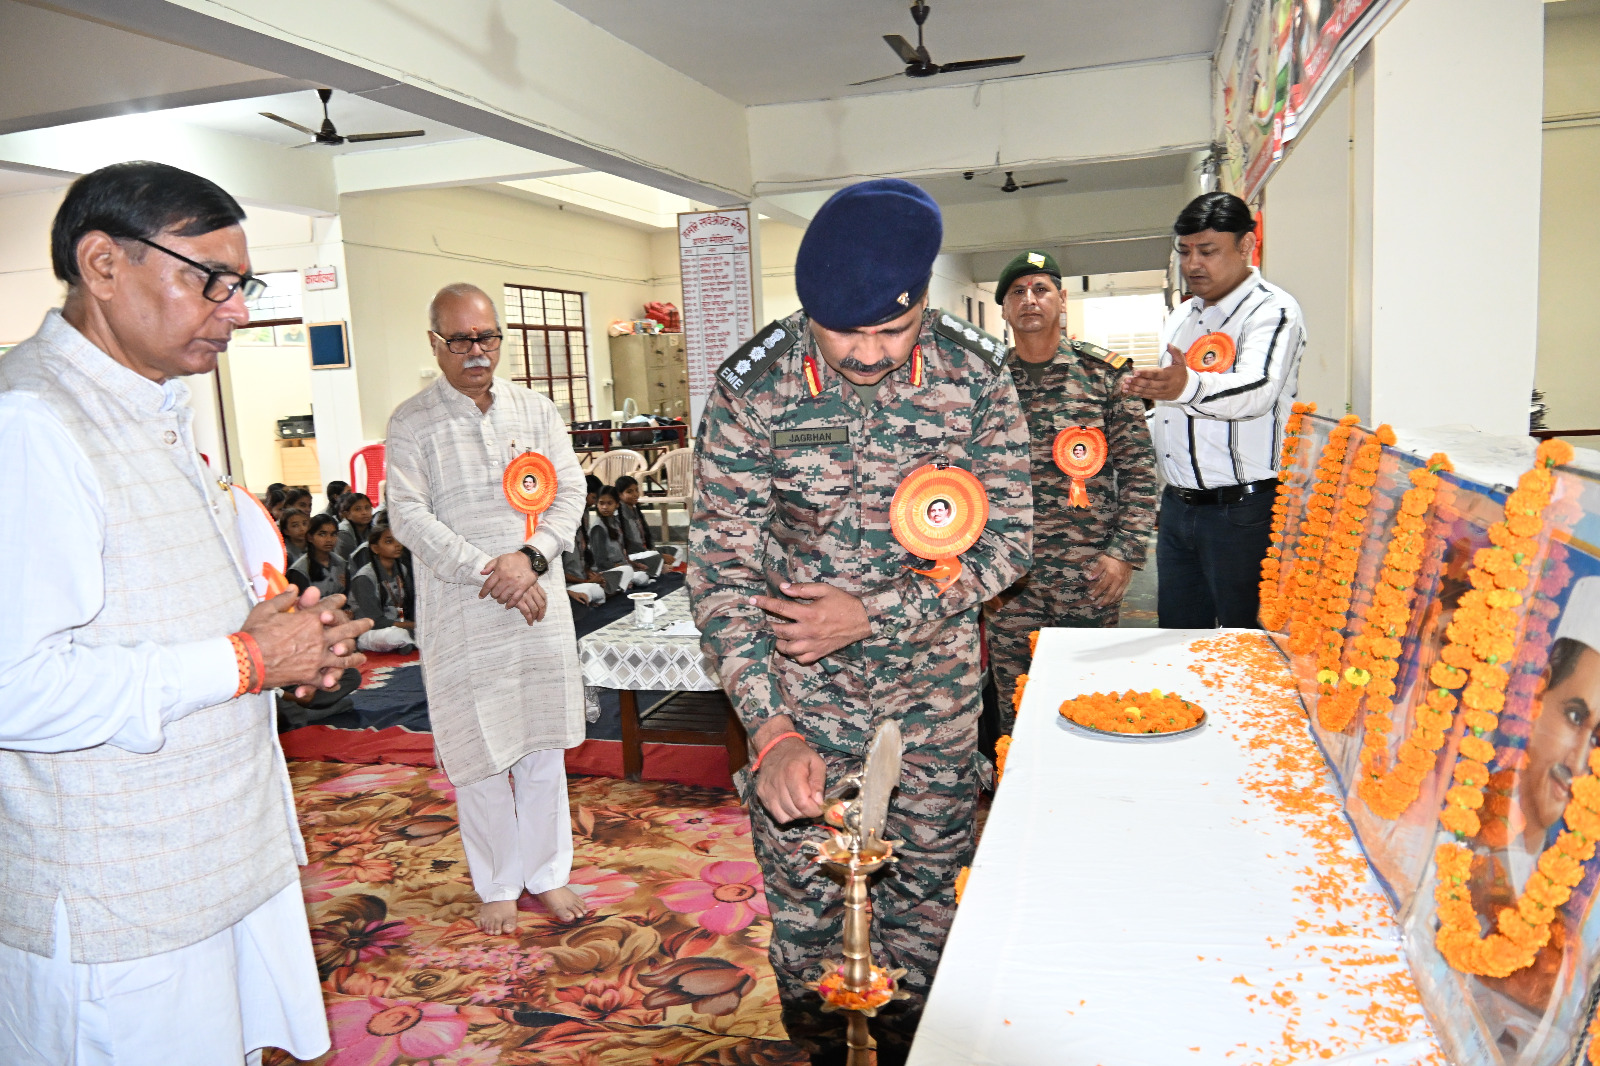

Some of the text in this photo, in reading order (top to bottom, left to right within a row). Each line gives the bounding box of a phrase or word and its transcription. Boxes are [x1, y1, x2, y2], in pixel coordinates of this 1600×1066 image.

[305, 270, 335, 284] कार्यालय
[993, 342, 1006, 367] EME
[720, 366, 744, 390] EME
[789, 433, 832, 442] JAGBHAN
